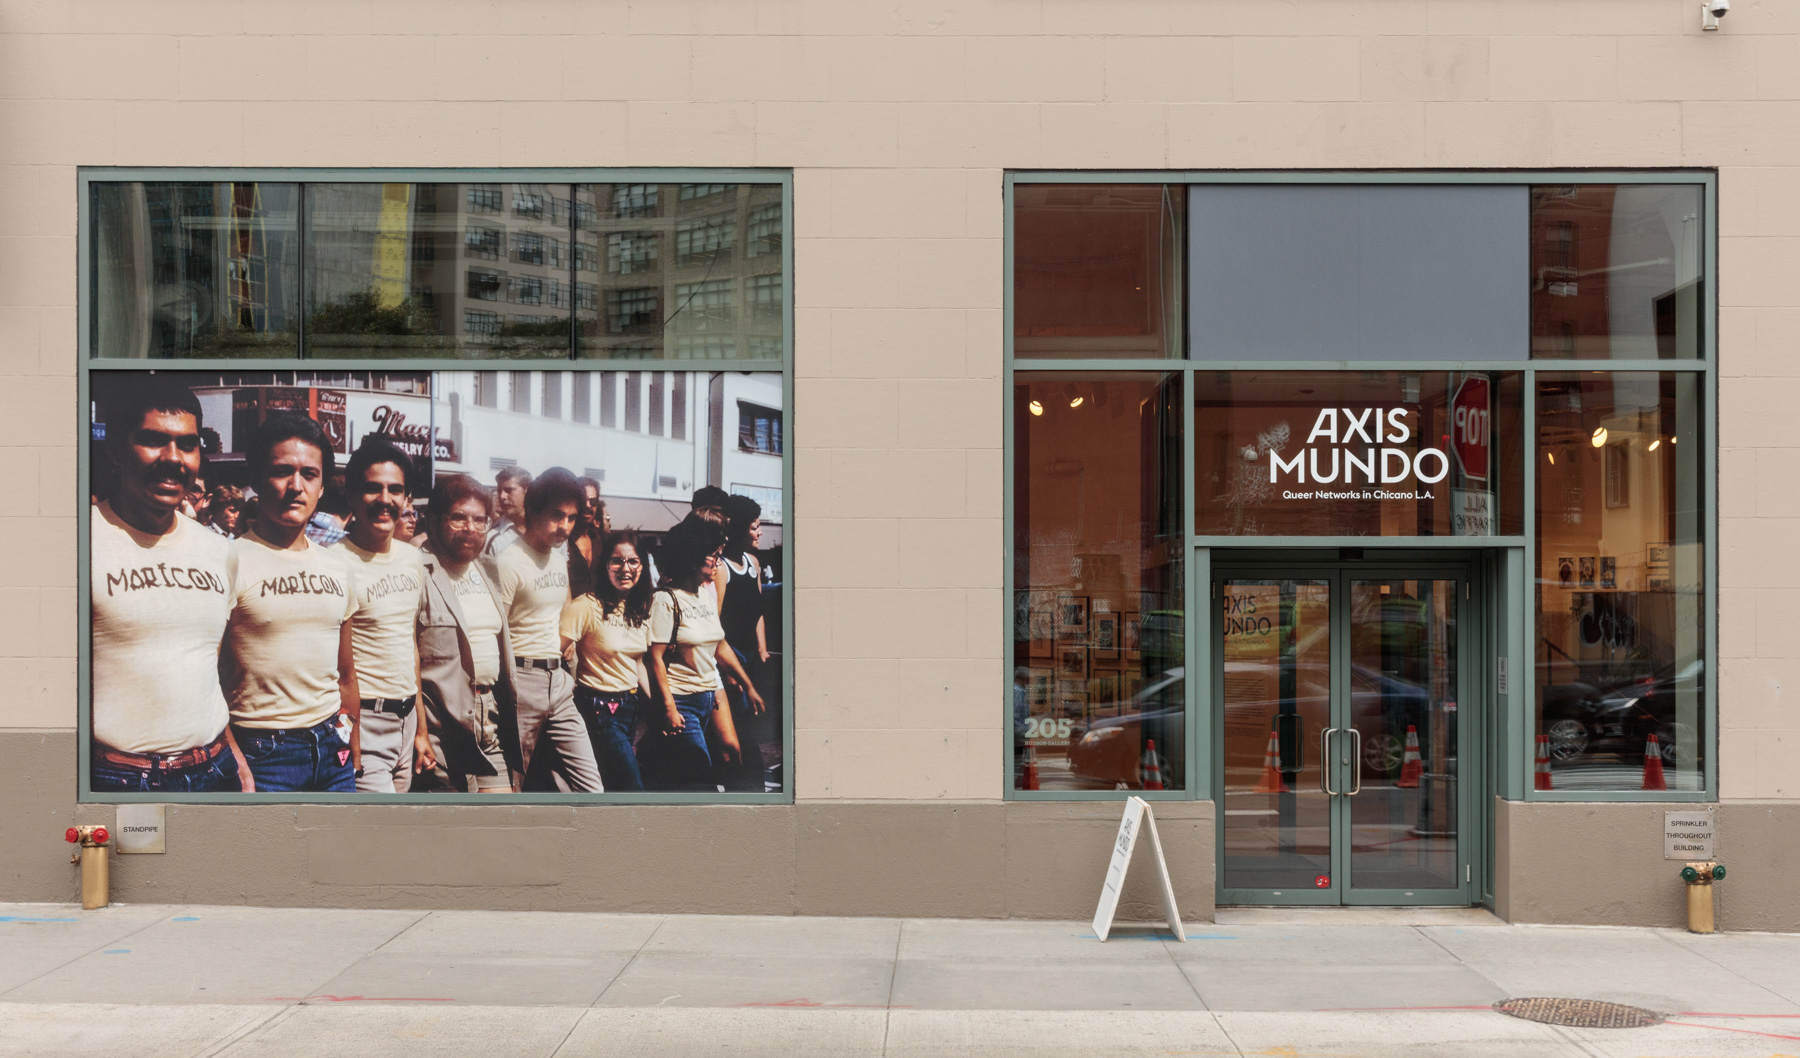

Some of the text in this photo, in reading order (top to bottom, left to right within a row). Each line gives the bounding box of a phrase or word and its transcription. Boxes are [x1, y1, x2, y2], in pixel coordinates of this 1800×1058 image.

[1306, 407, 1410, 444] AXIS
[1270, 448, 1449, 484] MUNDO
[1283, 490, 1434, 499] Queer Networks in Chicano L.A.
[106, 562, 225, 597] MARICON
[260, 570, 344, 598] MARICON
[366, 570, 420, 603] MARICON
[1024, 717, 1072, 739] 205
